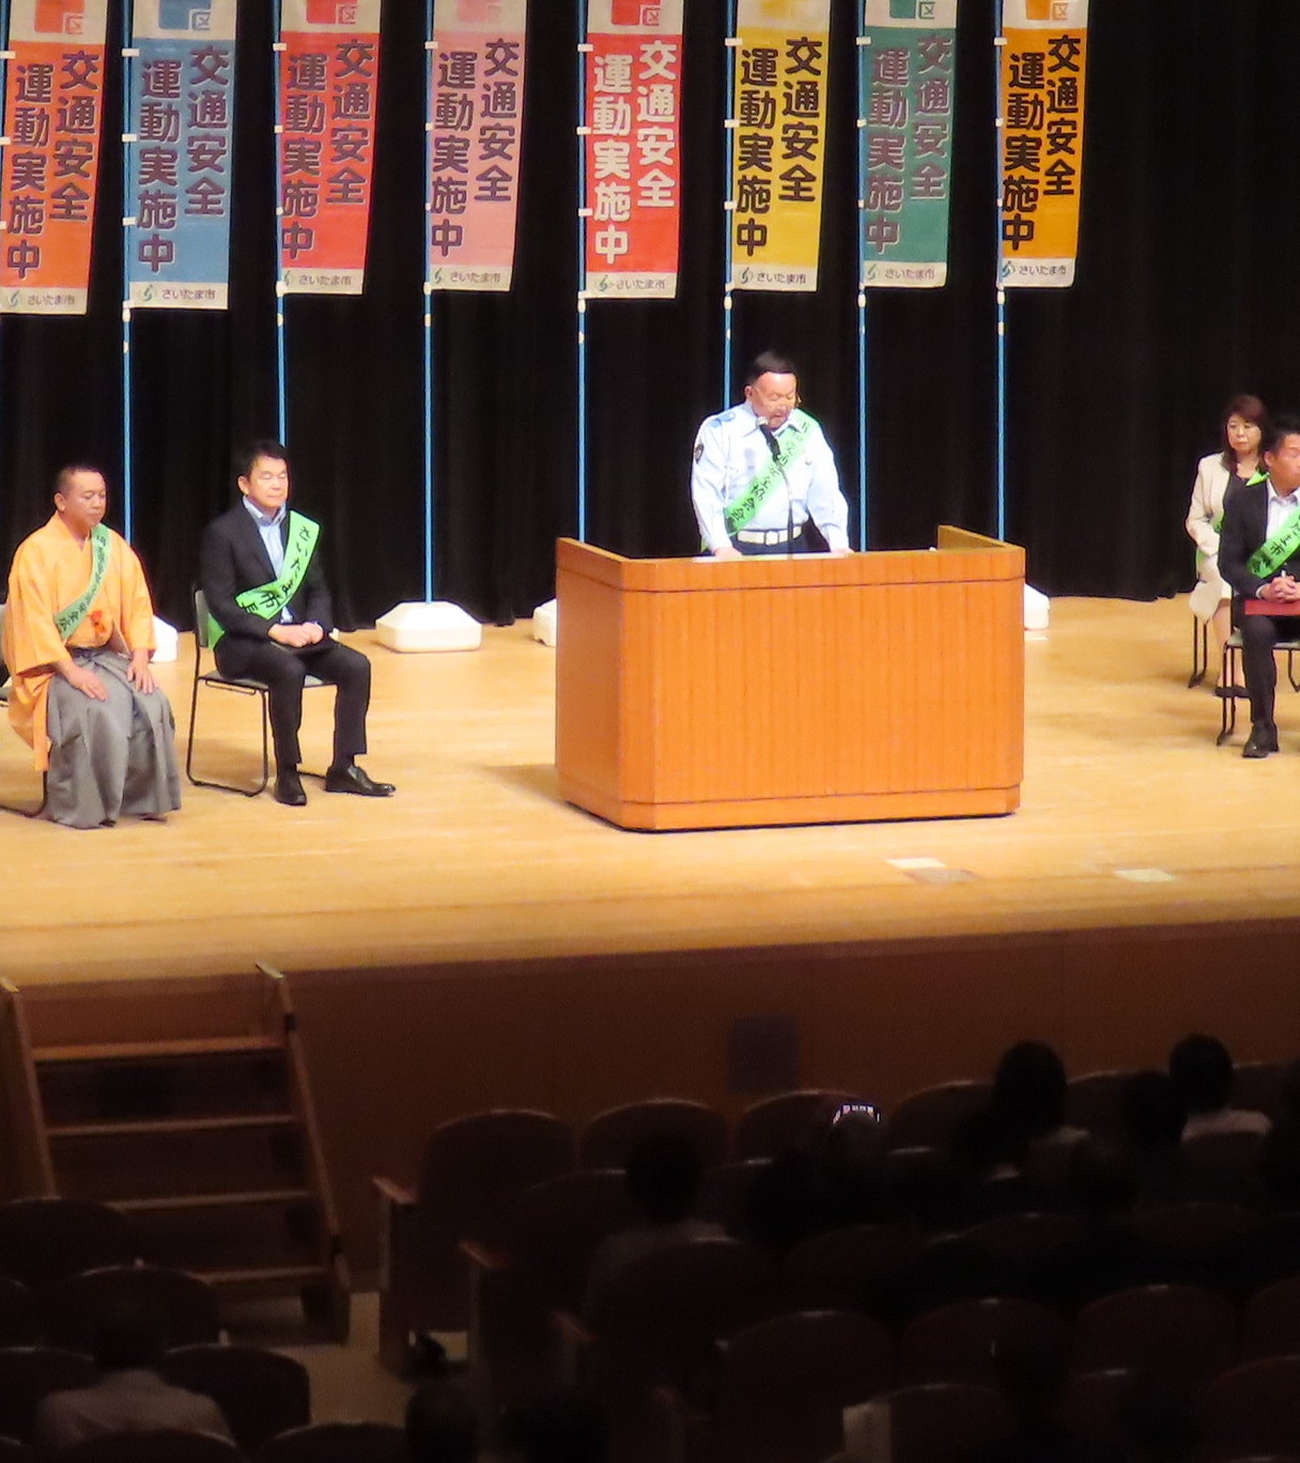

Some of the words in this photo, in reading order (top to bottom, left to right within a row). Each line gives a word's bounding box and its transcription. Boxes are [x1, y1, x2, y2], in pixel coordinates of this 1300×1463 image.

[6, 64, 54, 279] 運動実施中
[49, 50, 99, 222] 交通安全
[137, 60, 181, 272] 運動実施中
[184, 44, 229, 216] 交通安全
[281, 53, 327, 259] 運動実施中
[326, 39, 375, 205] 交通安全
[431, 51, 478, 257] 運動実施中
[475, 37, 520, 202] 交通安全
[592, 54, 631, 265] 運動実施中
[637, 40, 677, 209] 交通安全
[736, 49, 778, 257] 運動実施中
[779, 36, 822, 203] 交通安全
[865, 48, 909, 252] 運動実施中
[914, 35, 953, 200] 交通安全
[1003, 52, 1045, 250] 運動実施中
[1043, 35, 1081, 197] 交通安全
[27, 294, 75, 306] さいたま市
[162, 288, 216, 301] さいたま市
[298, 273, 352, 286] さいたま市
[450, 271, 502, 283] さいたま市
[616, 278, 665, 290] さいたま市
[757, 272, 807, 284] さいたま市
[885, 267, 935, 280] さいたま市
[1019, 265, 1067, 277] さいたま市
